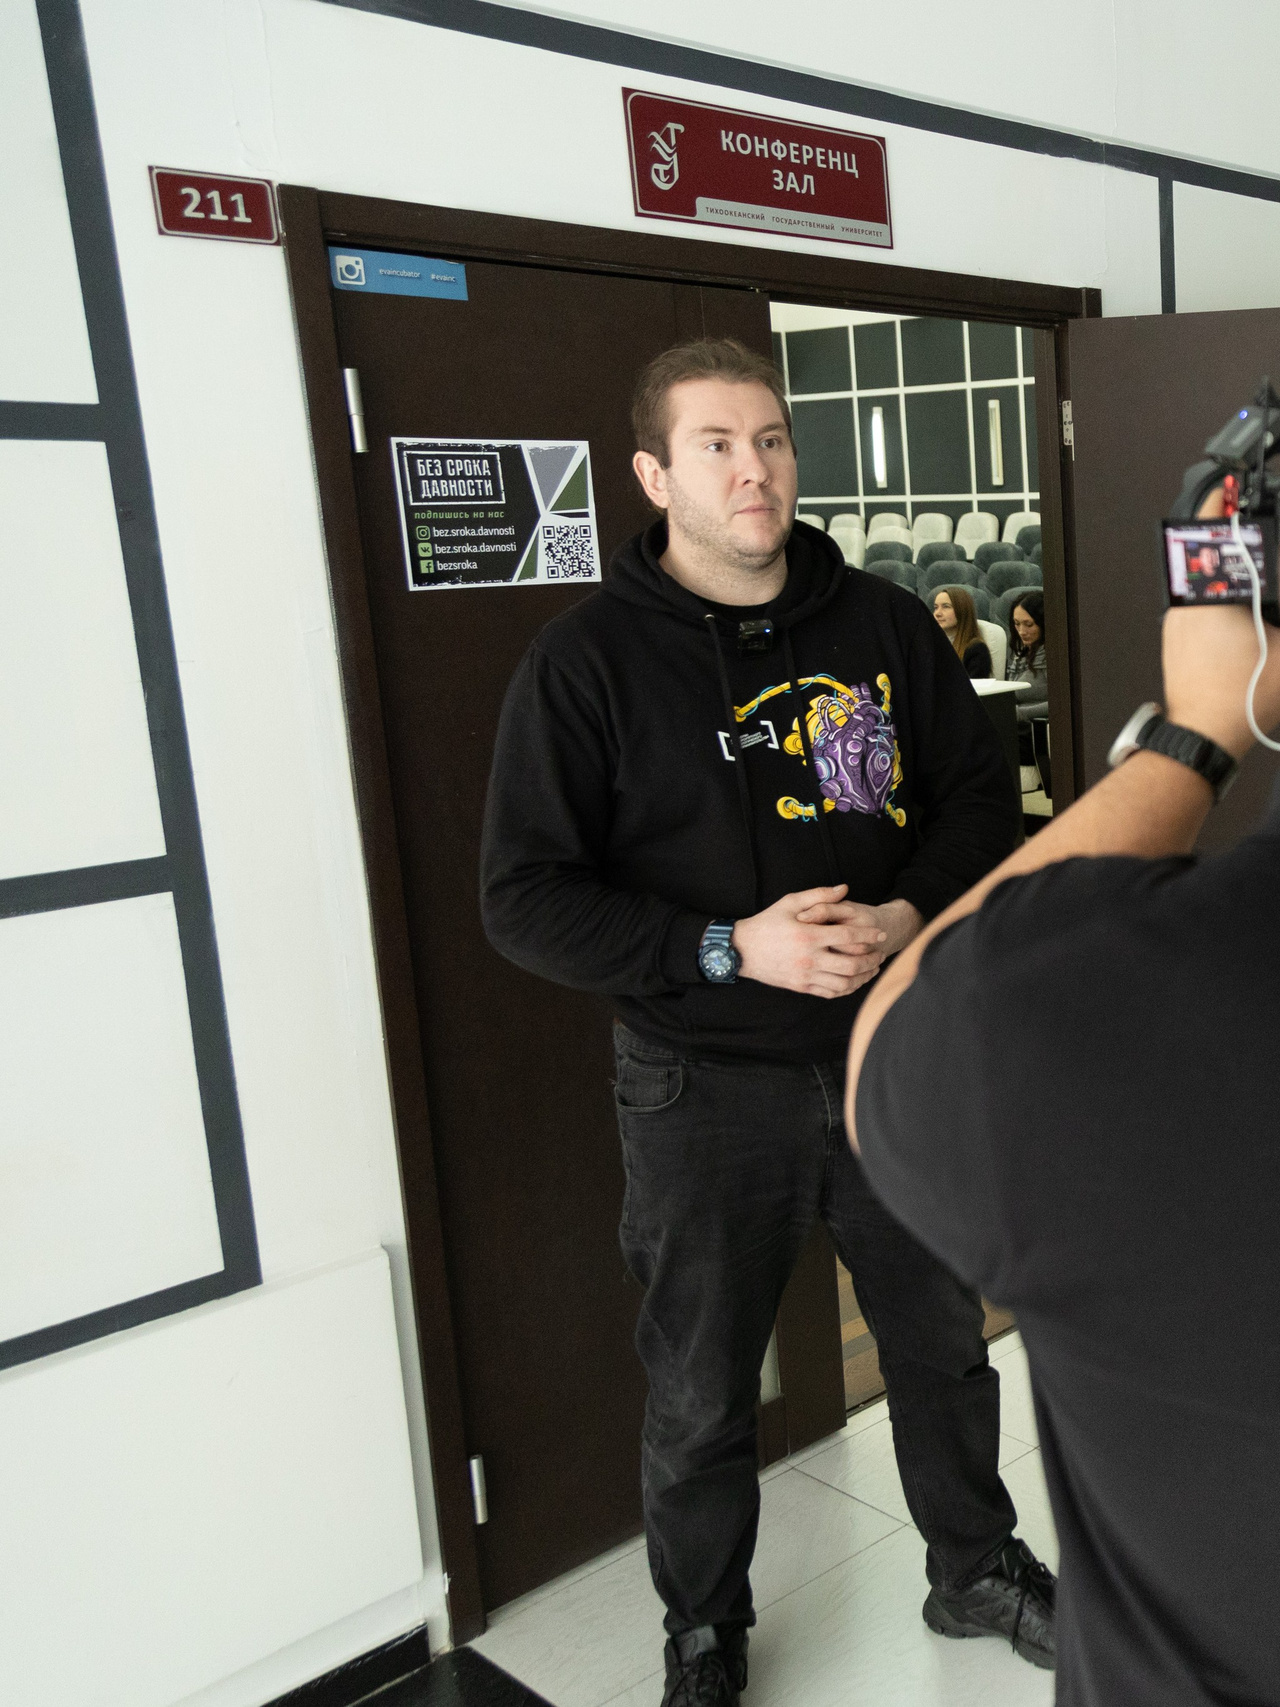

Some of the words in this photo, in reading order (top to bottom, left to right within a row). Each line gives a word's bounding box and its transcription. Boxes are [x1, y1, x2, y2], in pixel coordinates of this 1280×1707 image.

[720, 130, 859, 178] КОНФЕРЕНЦ
[772, 169, 816, 196] ЗАЛ
[180, 187, 252, 223] 211
[705, 206, 766, 221] ТИХООКЕАНСКИЙ
[772, 216, 836, 231] ГОСУДАРСТВЕННЫЙ
[841, 226, 883, 238] УНИВЕРСИТЕТ
[417, 459, 442, 476] БЕЗ
[446, 459, 491, 476] СРОКА
[421, 480, 493, 498] ДАВНОСТИ
[414, 510, 469, 519] подпишись
[433, 526, 515, 537] bez.sroka.davnosti
[435, 542, 517, 554] bez.sroka.davnosti
[437, 560, 478, 570] bezsroka
